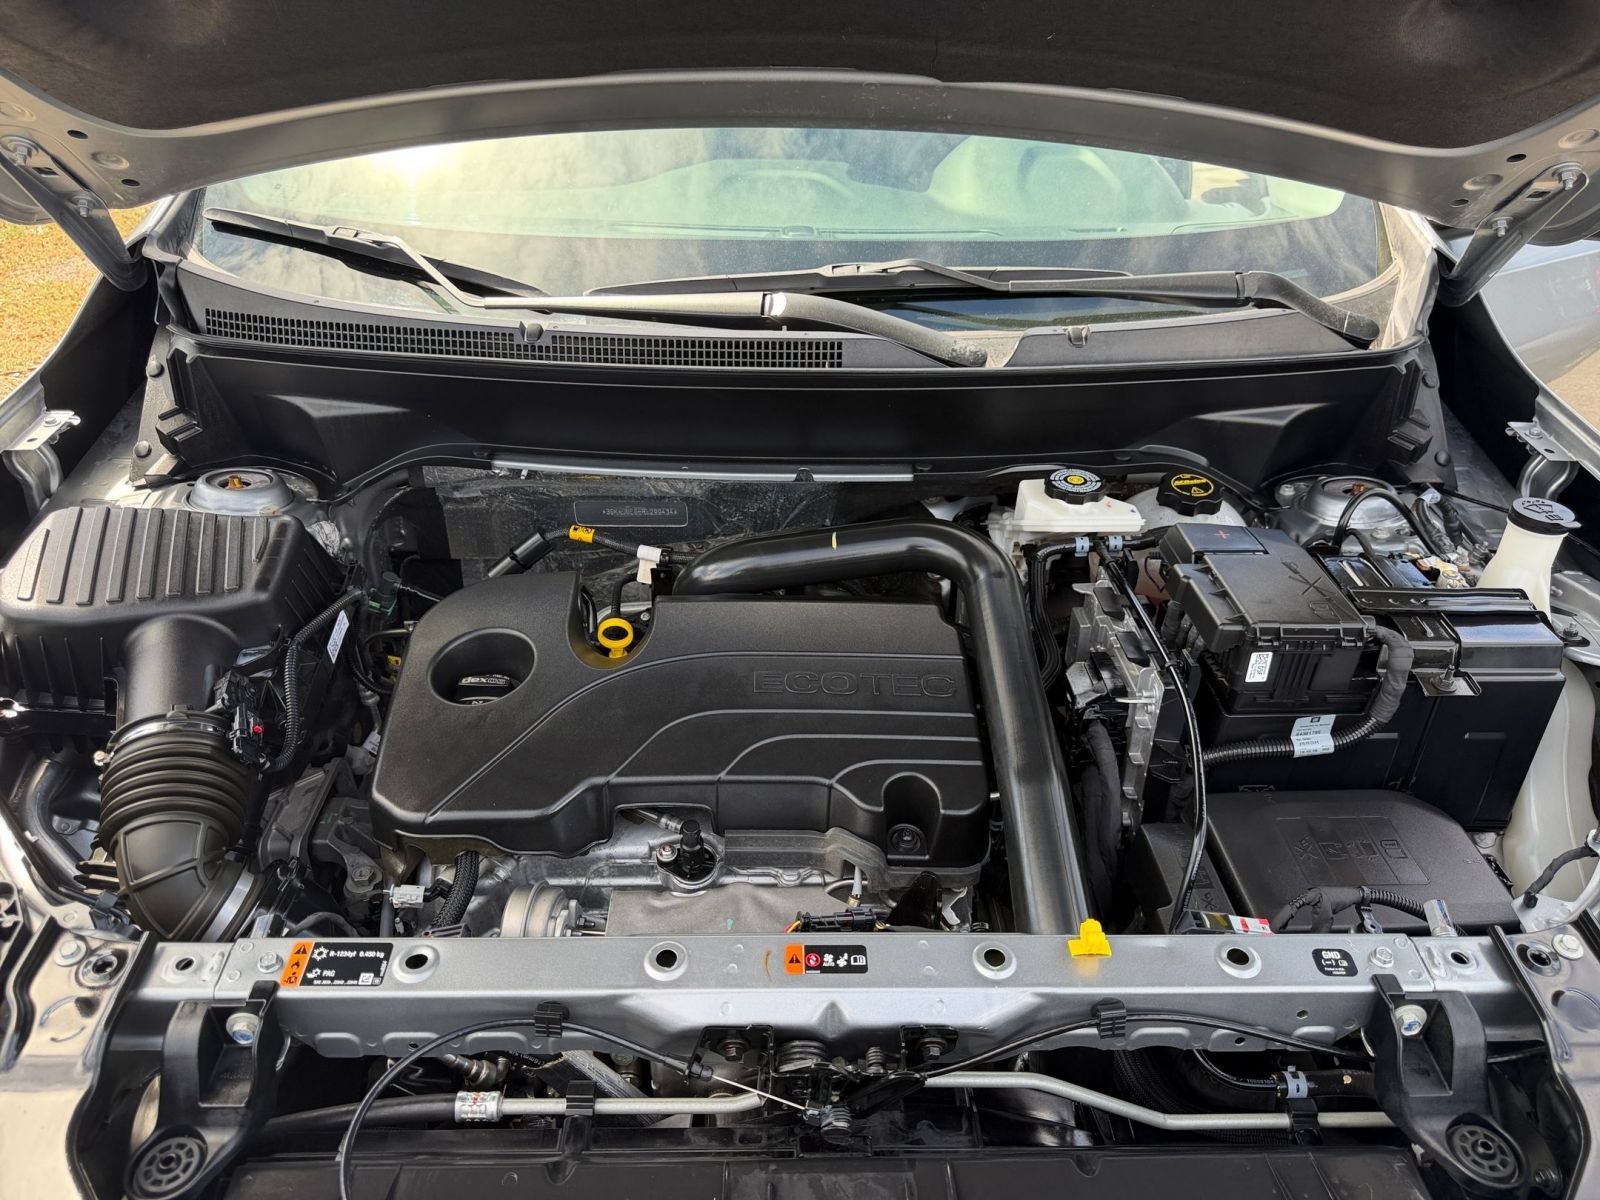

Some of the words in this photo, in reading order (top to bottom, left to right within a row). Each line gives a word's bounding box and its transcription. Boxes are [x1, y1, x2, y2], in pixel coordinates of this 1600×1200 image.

[462, 676, 506, 685] dexos
[753, 671, 955, 697] ECOTEC
[329, 950, 357, 958] R-1234yf
[376, 950, 385, 959] kg
[1321, 950, 1341, 959] GND
